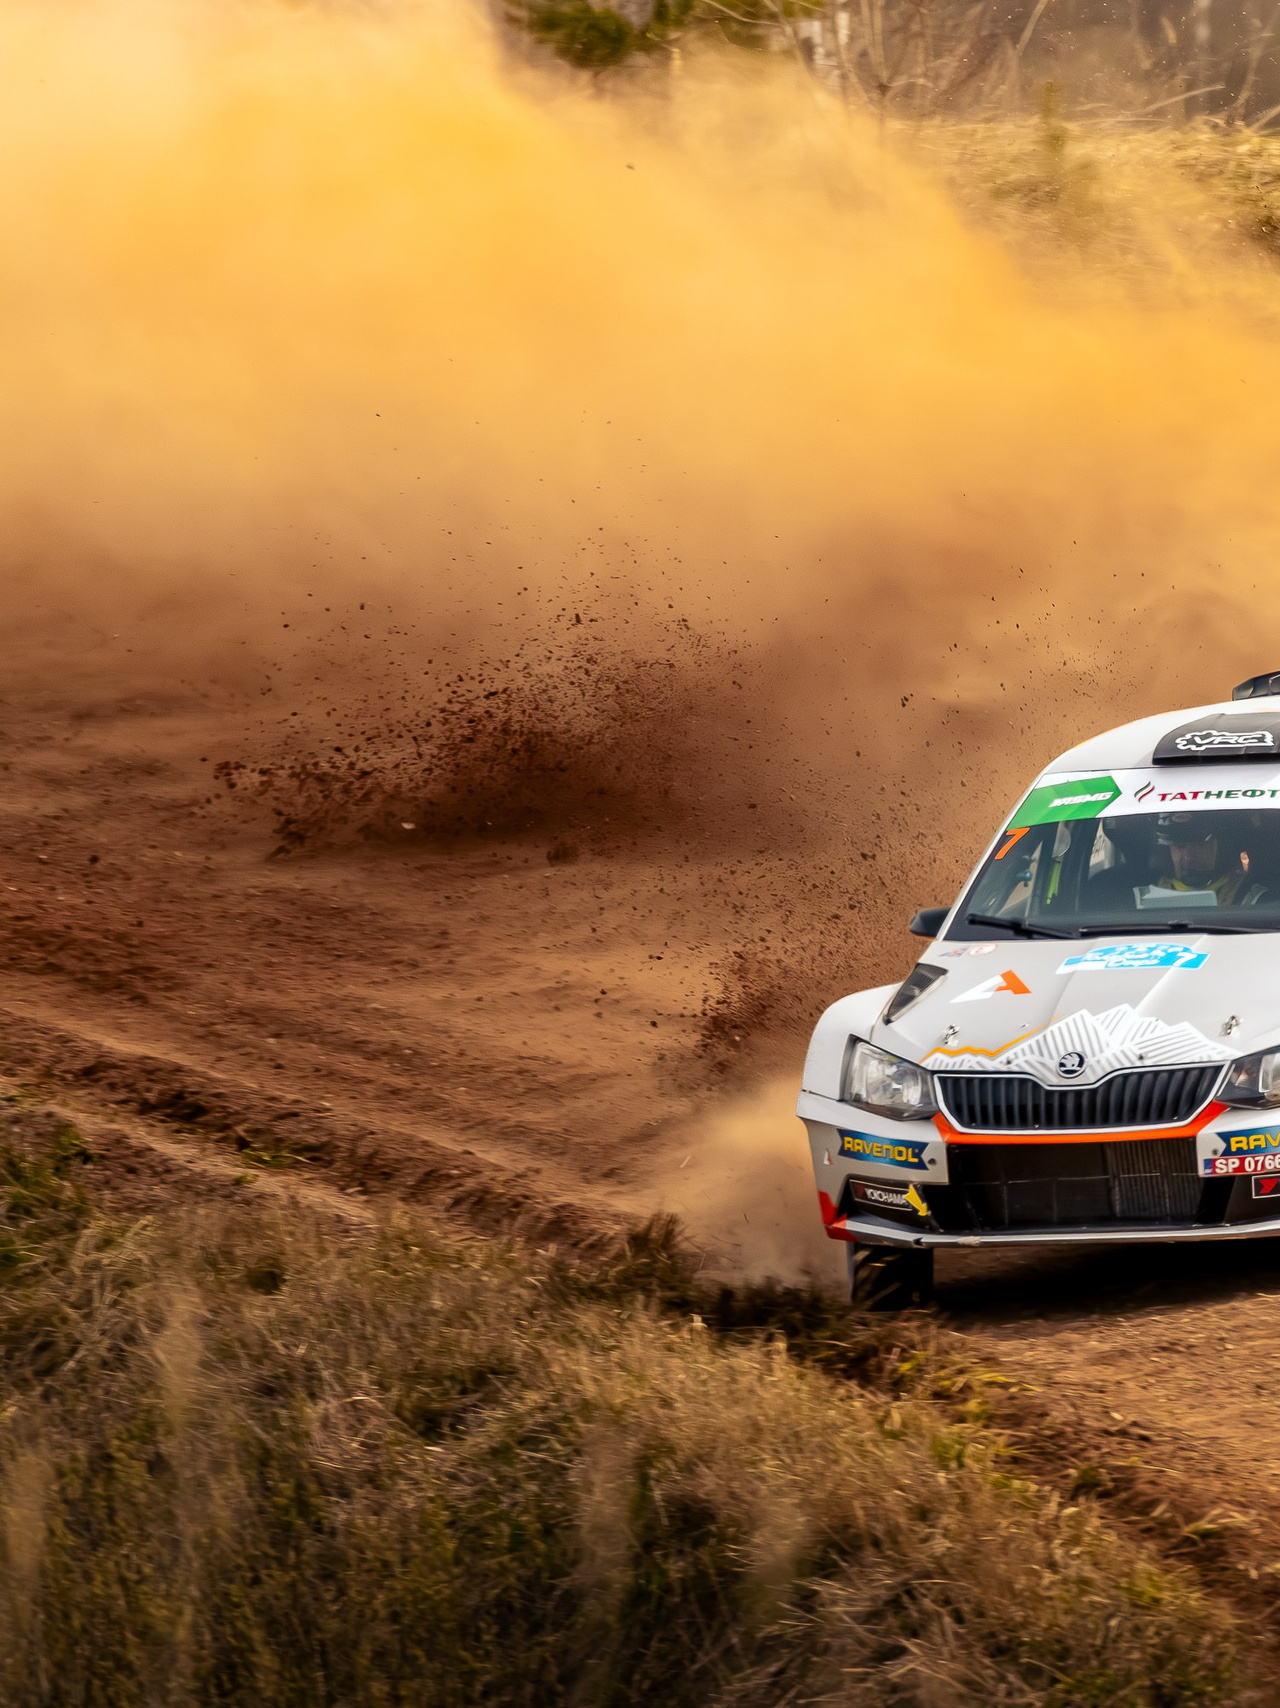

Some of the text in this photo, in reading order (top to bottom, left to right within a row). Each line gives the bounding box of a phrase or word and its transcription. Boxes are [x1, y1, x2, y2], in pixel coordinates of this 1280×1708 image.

[994, 827, 1031, 860] 7
[843, 1136, 919, 1163] RAVENOL
[1214, 1157, 1240, 1174] SP
